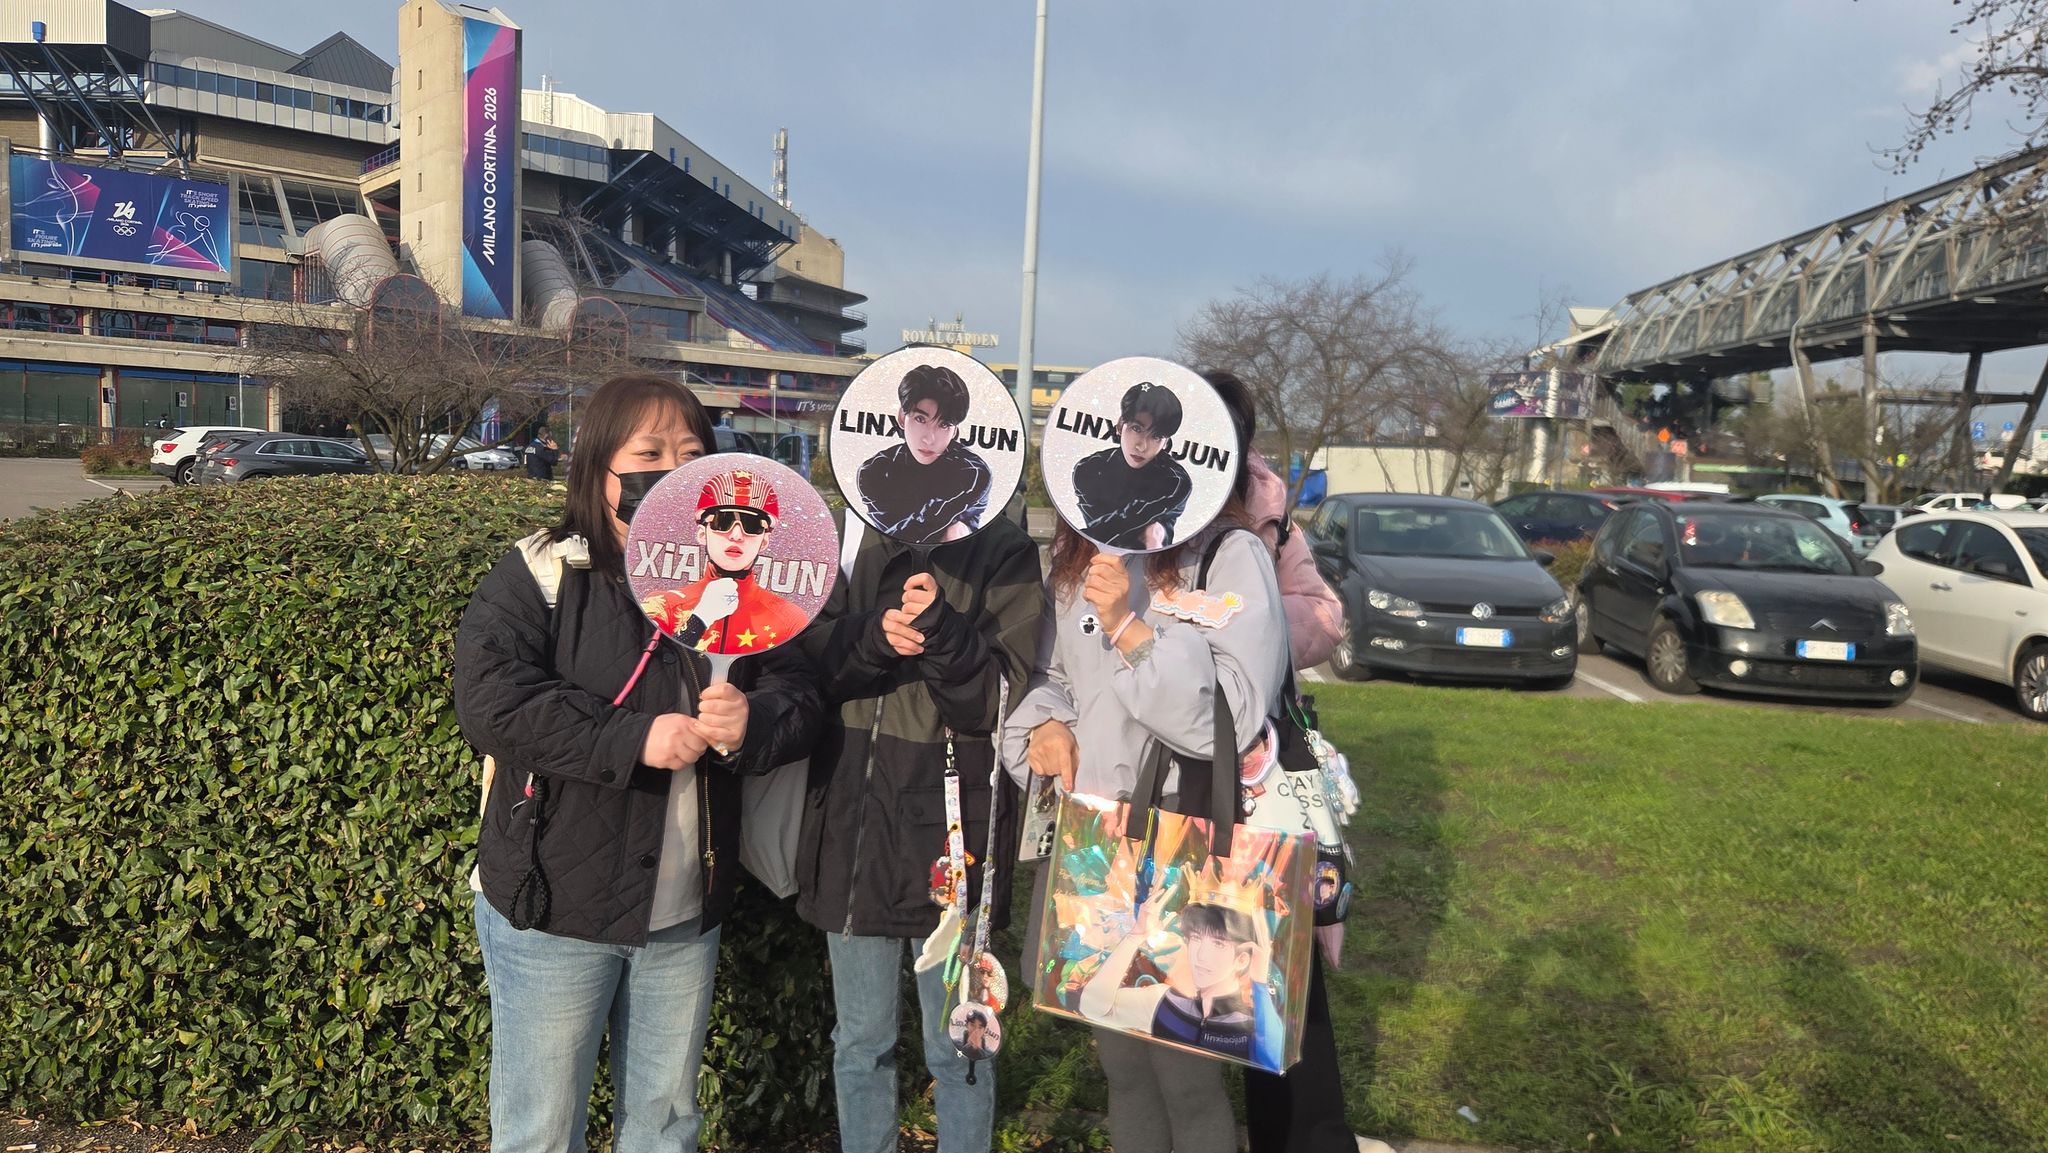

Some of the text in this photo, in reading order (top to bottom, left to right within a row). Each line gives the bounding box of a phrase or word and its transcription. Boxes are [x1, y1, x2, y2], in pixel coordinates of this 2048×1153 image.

[482, 87, 497, 266] MILANO CORTINA 2026
[938, 322, 966, 331] HOTEL
[902, 329, 999, 346] ROYAL GARDEN
